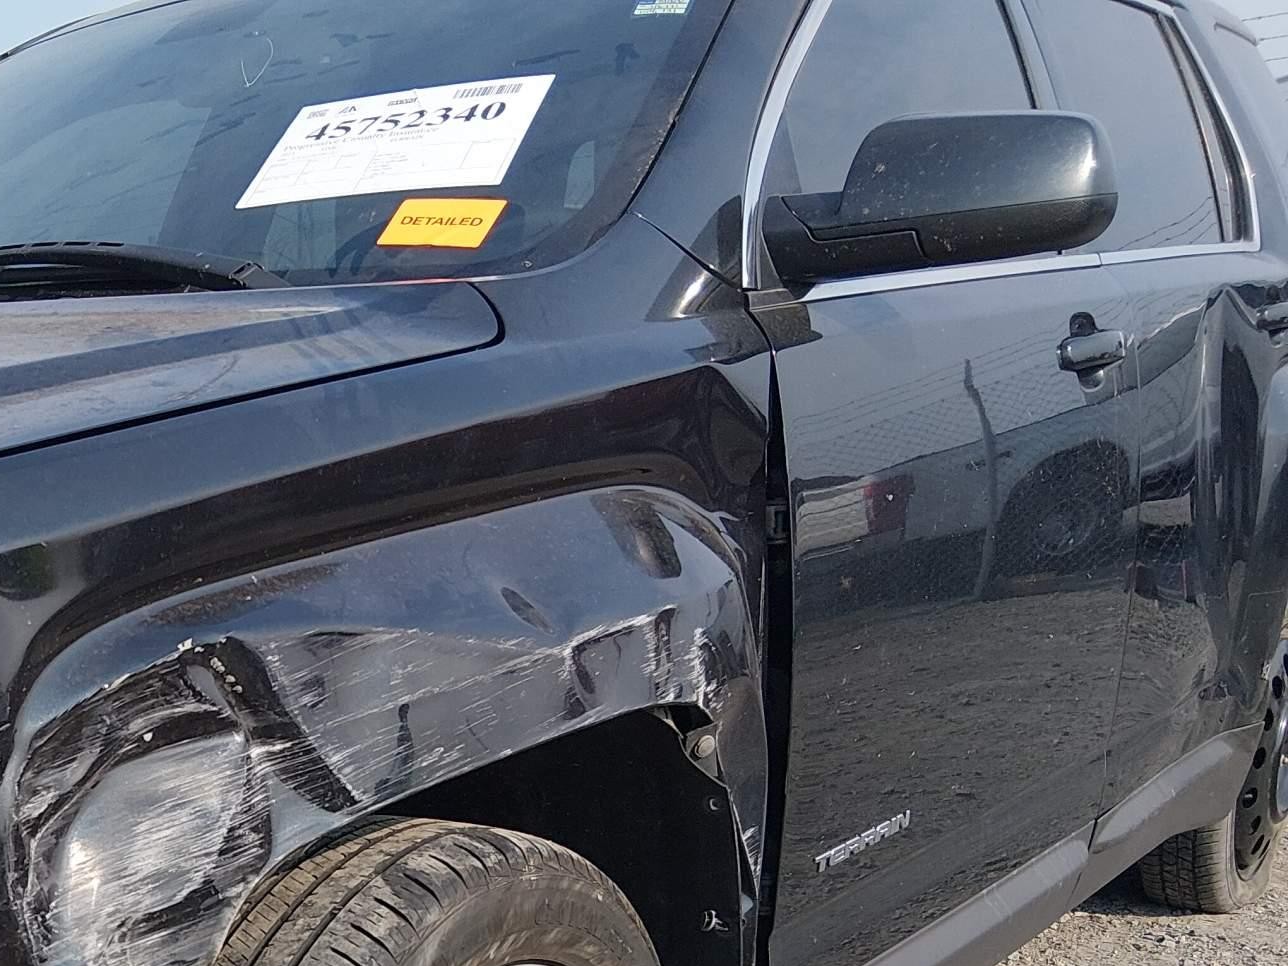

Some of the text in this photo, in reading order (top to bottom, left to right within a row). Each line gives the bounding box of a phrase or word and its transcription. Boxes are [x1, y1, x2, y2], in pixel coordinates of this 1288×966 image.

[305, 101, 507, 141] 45752340
[400, 215, 484, 228] DETAILED
[814, 809, 911, 873] TERRAIN
